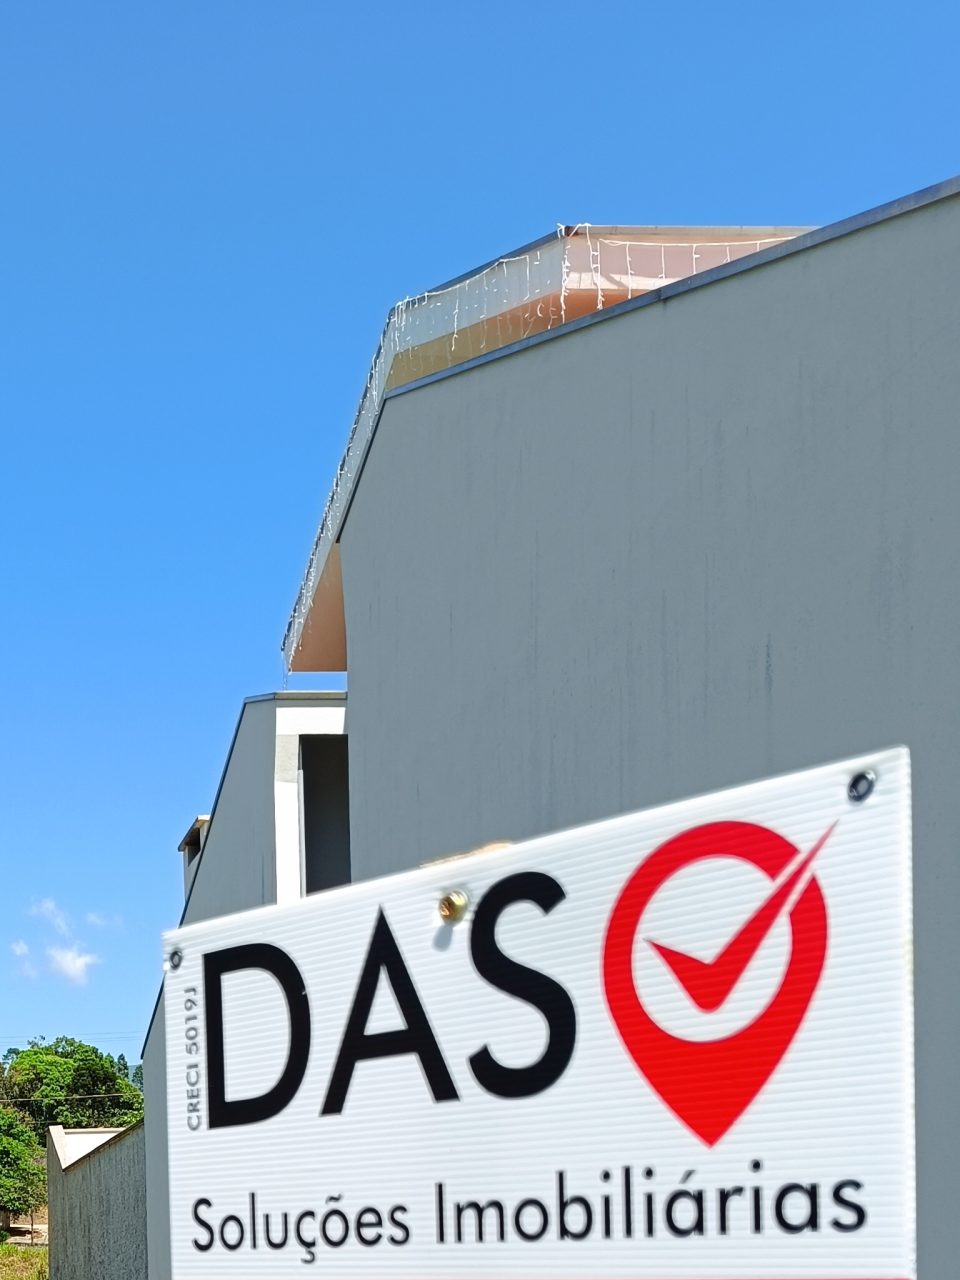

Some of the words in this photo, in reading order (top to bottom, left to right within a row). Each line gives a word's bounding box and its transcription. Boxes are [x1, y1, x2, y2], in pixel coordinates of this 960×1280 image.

[186, 1063, 201, 1132] CRECI
[191, 1192, 410, 1264] Soluções
[435, 1160, 867, 1244] Imobiliárias
